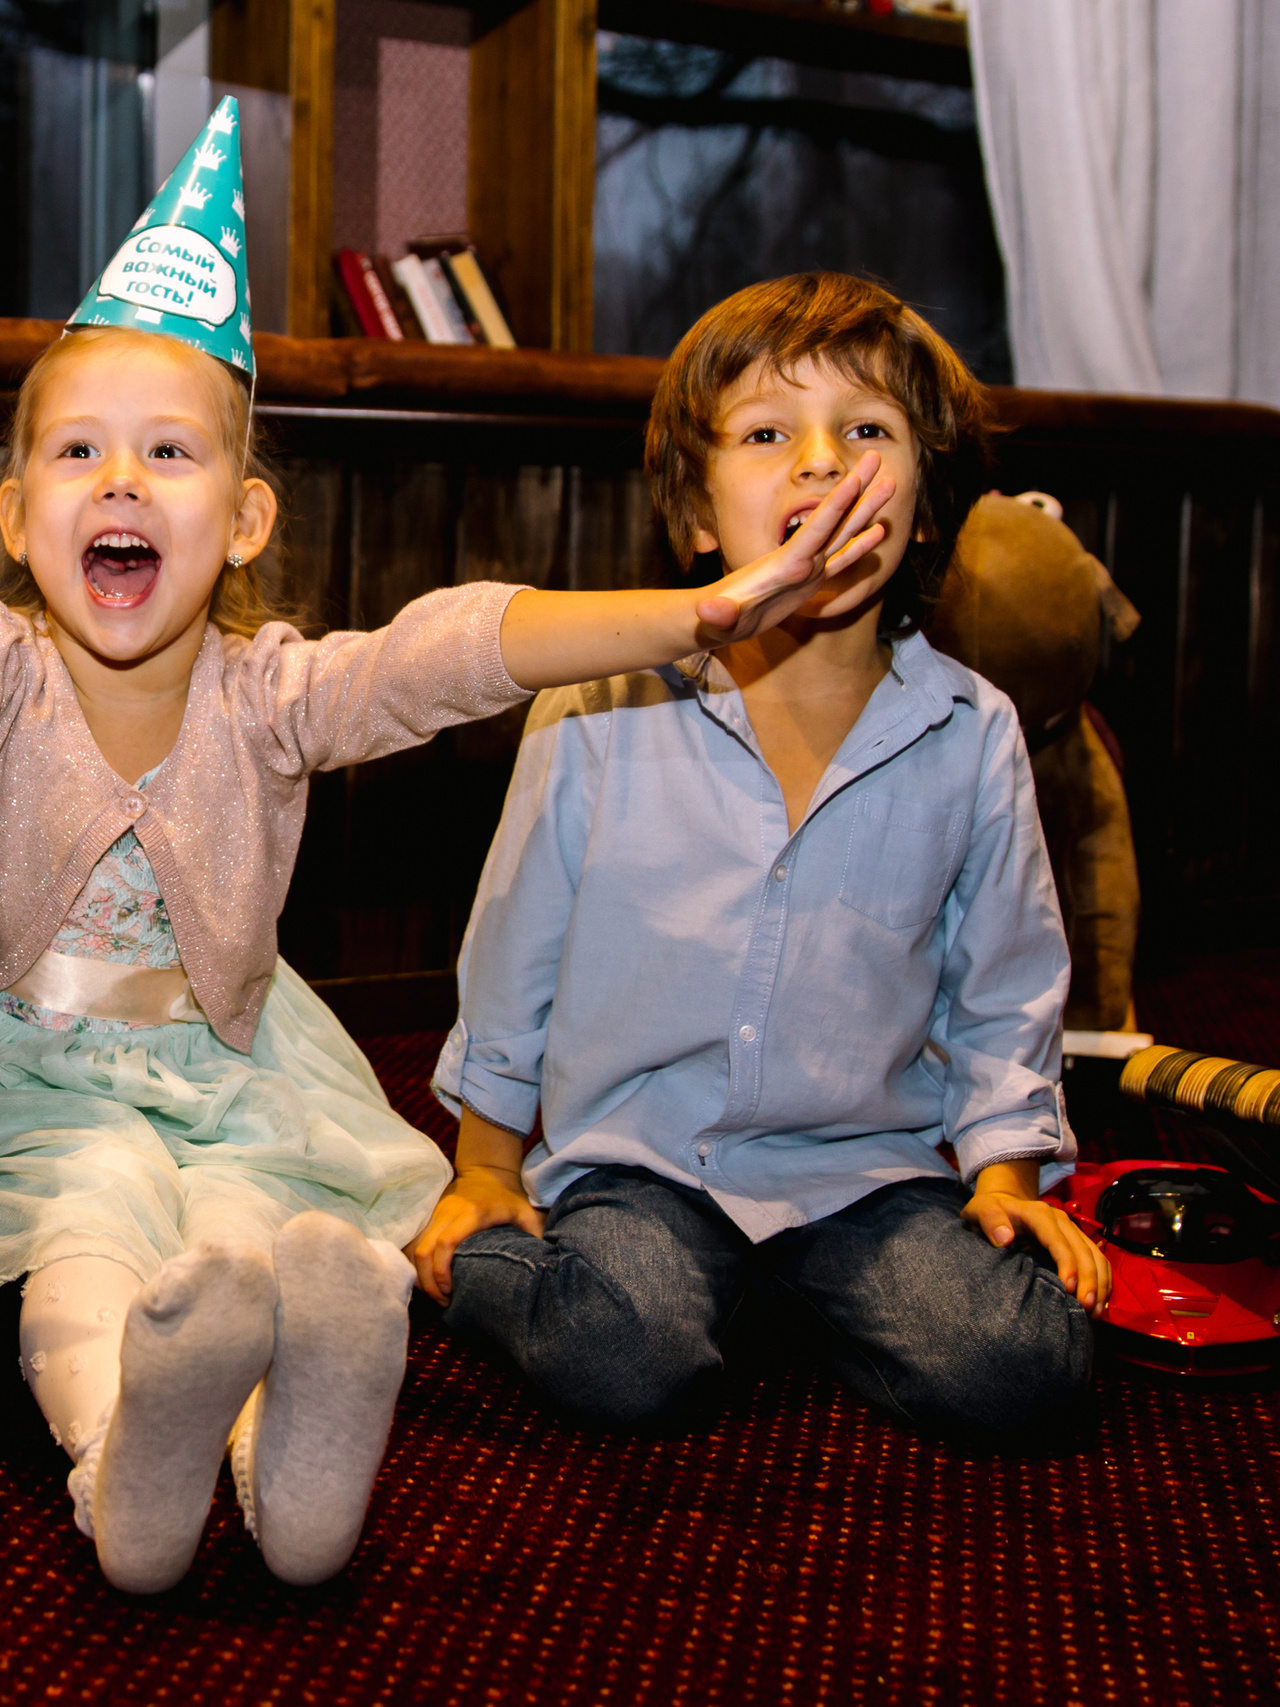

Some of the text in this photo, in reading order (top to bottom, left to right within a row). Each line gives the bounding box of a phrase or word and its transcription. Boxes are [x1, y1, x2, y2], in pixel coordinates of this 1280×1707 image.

[135, 236, 216, 273] Самый
[122, 261, 218, 298] важный
[126, 280, 194, 308] гость!
